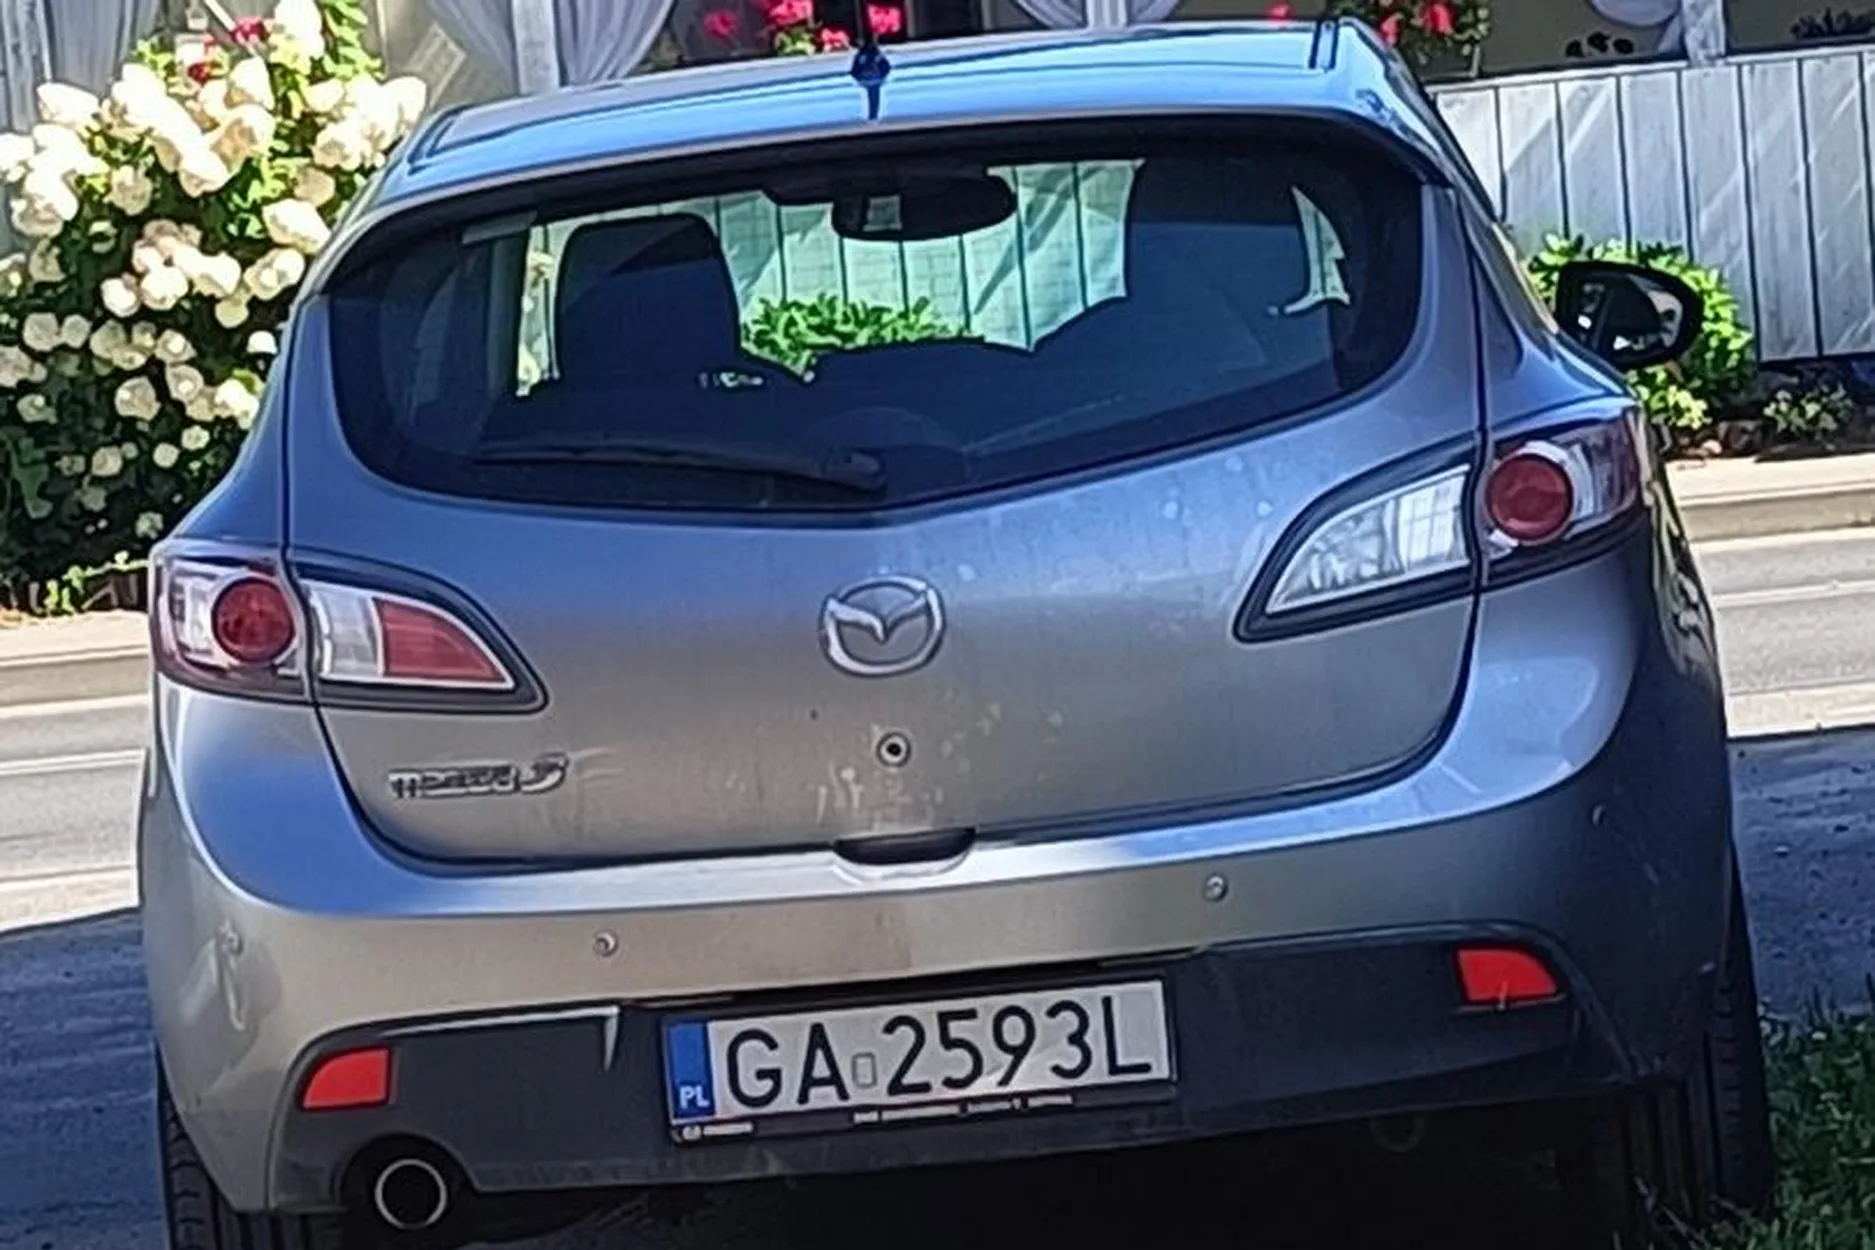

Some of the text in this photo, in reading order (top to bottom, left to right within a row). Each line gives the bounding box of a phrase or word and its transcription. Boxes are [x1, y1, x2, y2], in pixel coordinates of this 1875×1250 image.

[725, 994, 1152, 1109] GA 2593L
[679, 1085, 710, 1109] PL
